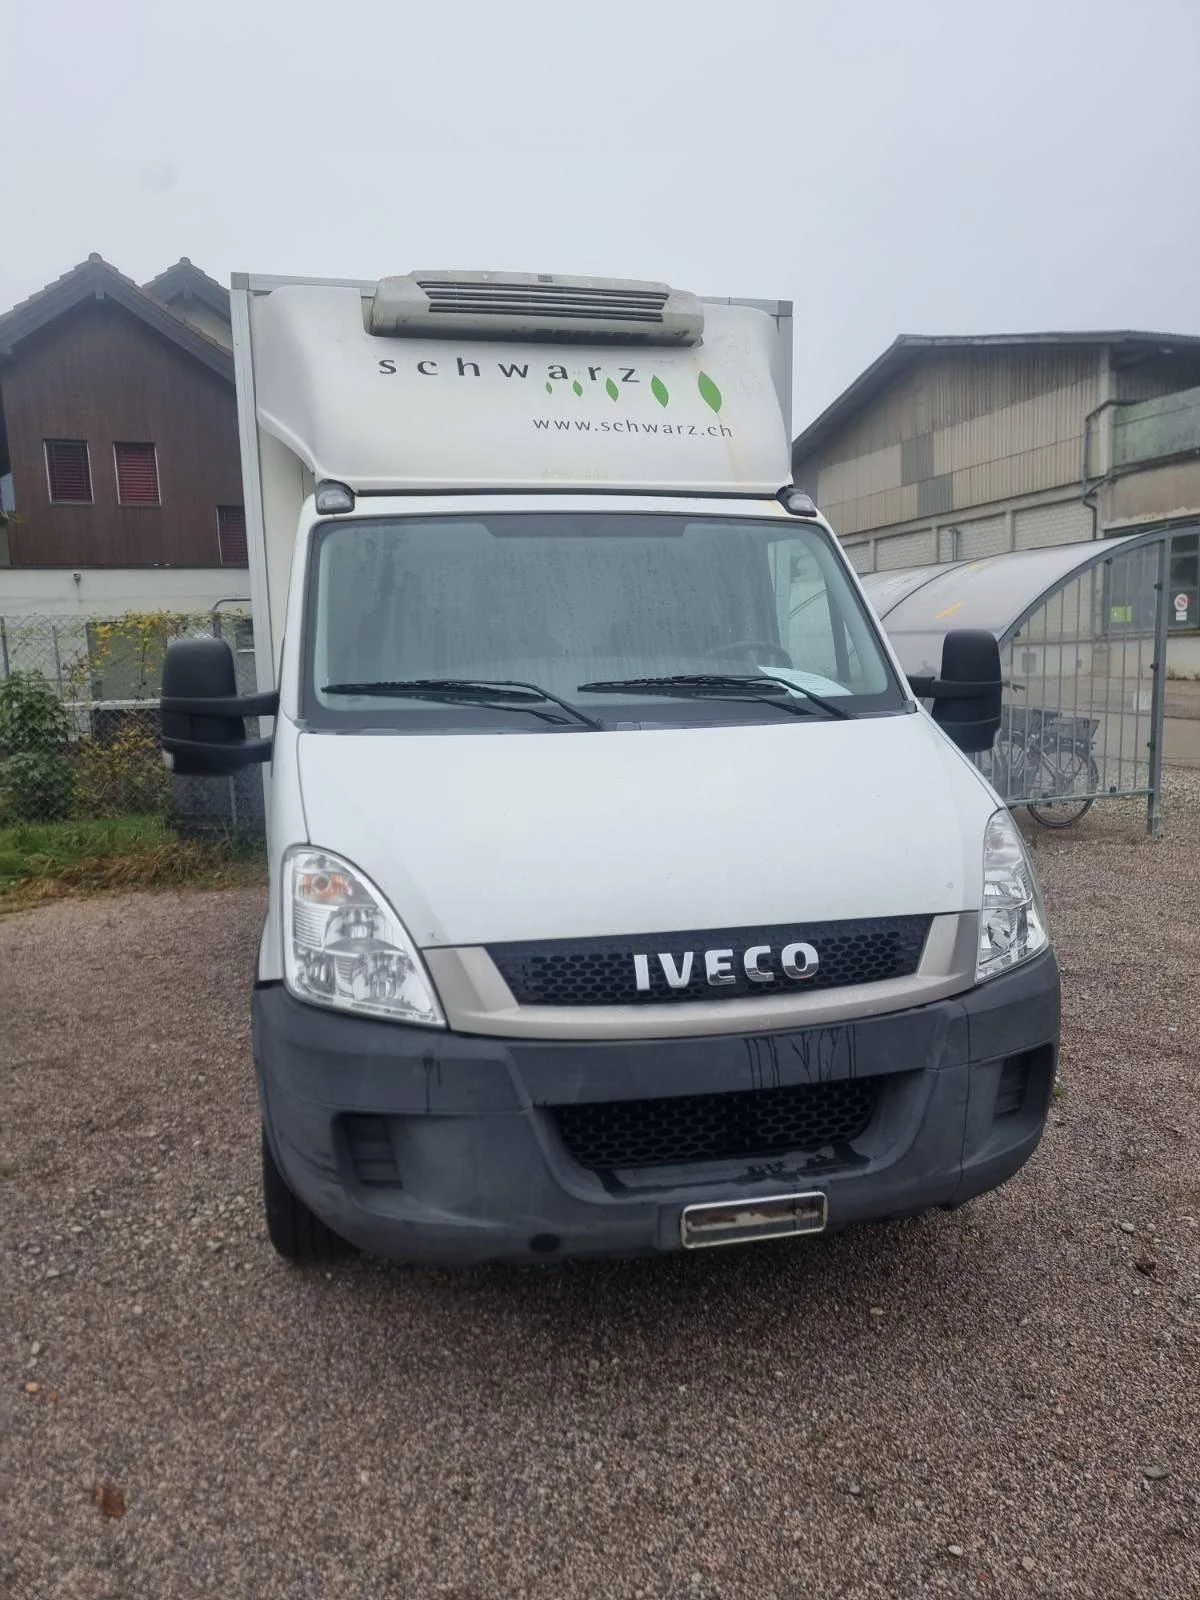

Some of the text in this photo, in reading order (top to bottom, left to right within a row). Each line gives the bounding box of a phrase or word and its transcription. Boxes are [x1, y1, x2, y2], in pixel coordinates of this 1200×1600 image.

[378, 357, 641, 384] schwarz
[532, 417, 733, 438] www.schwarz.ch
[633, 942, 820, 991] IVECO
